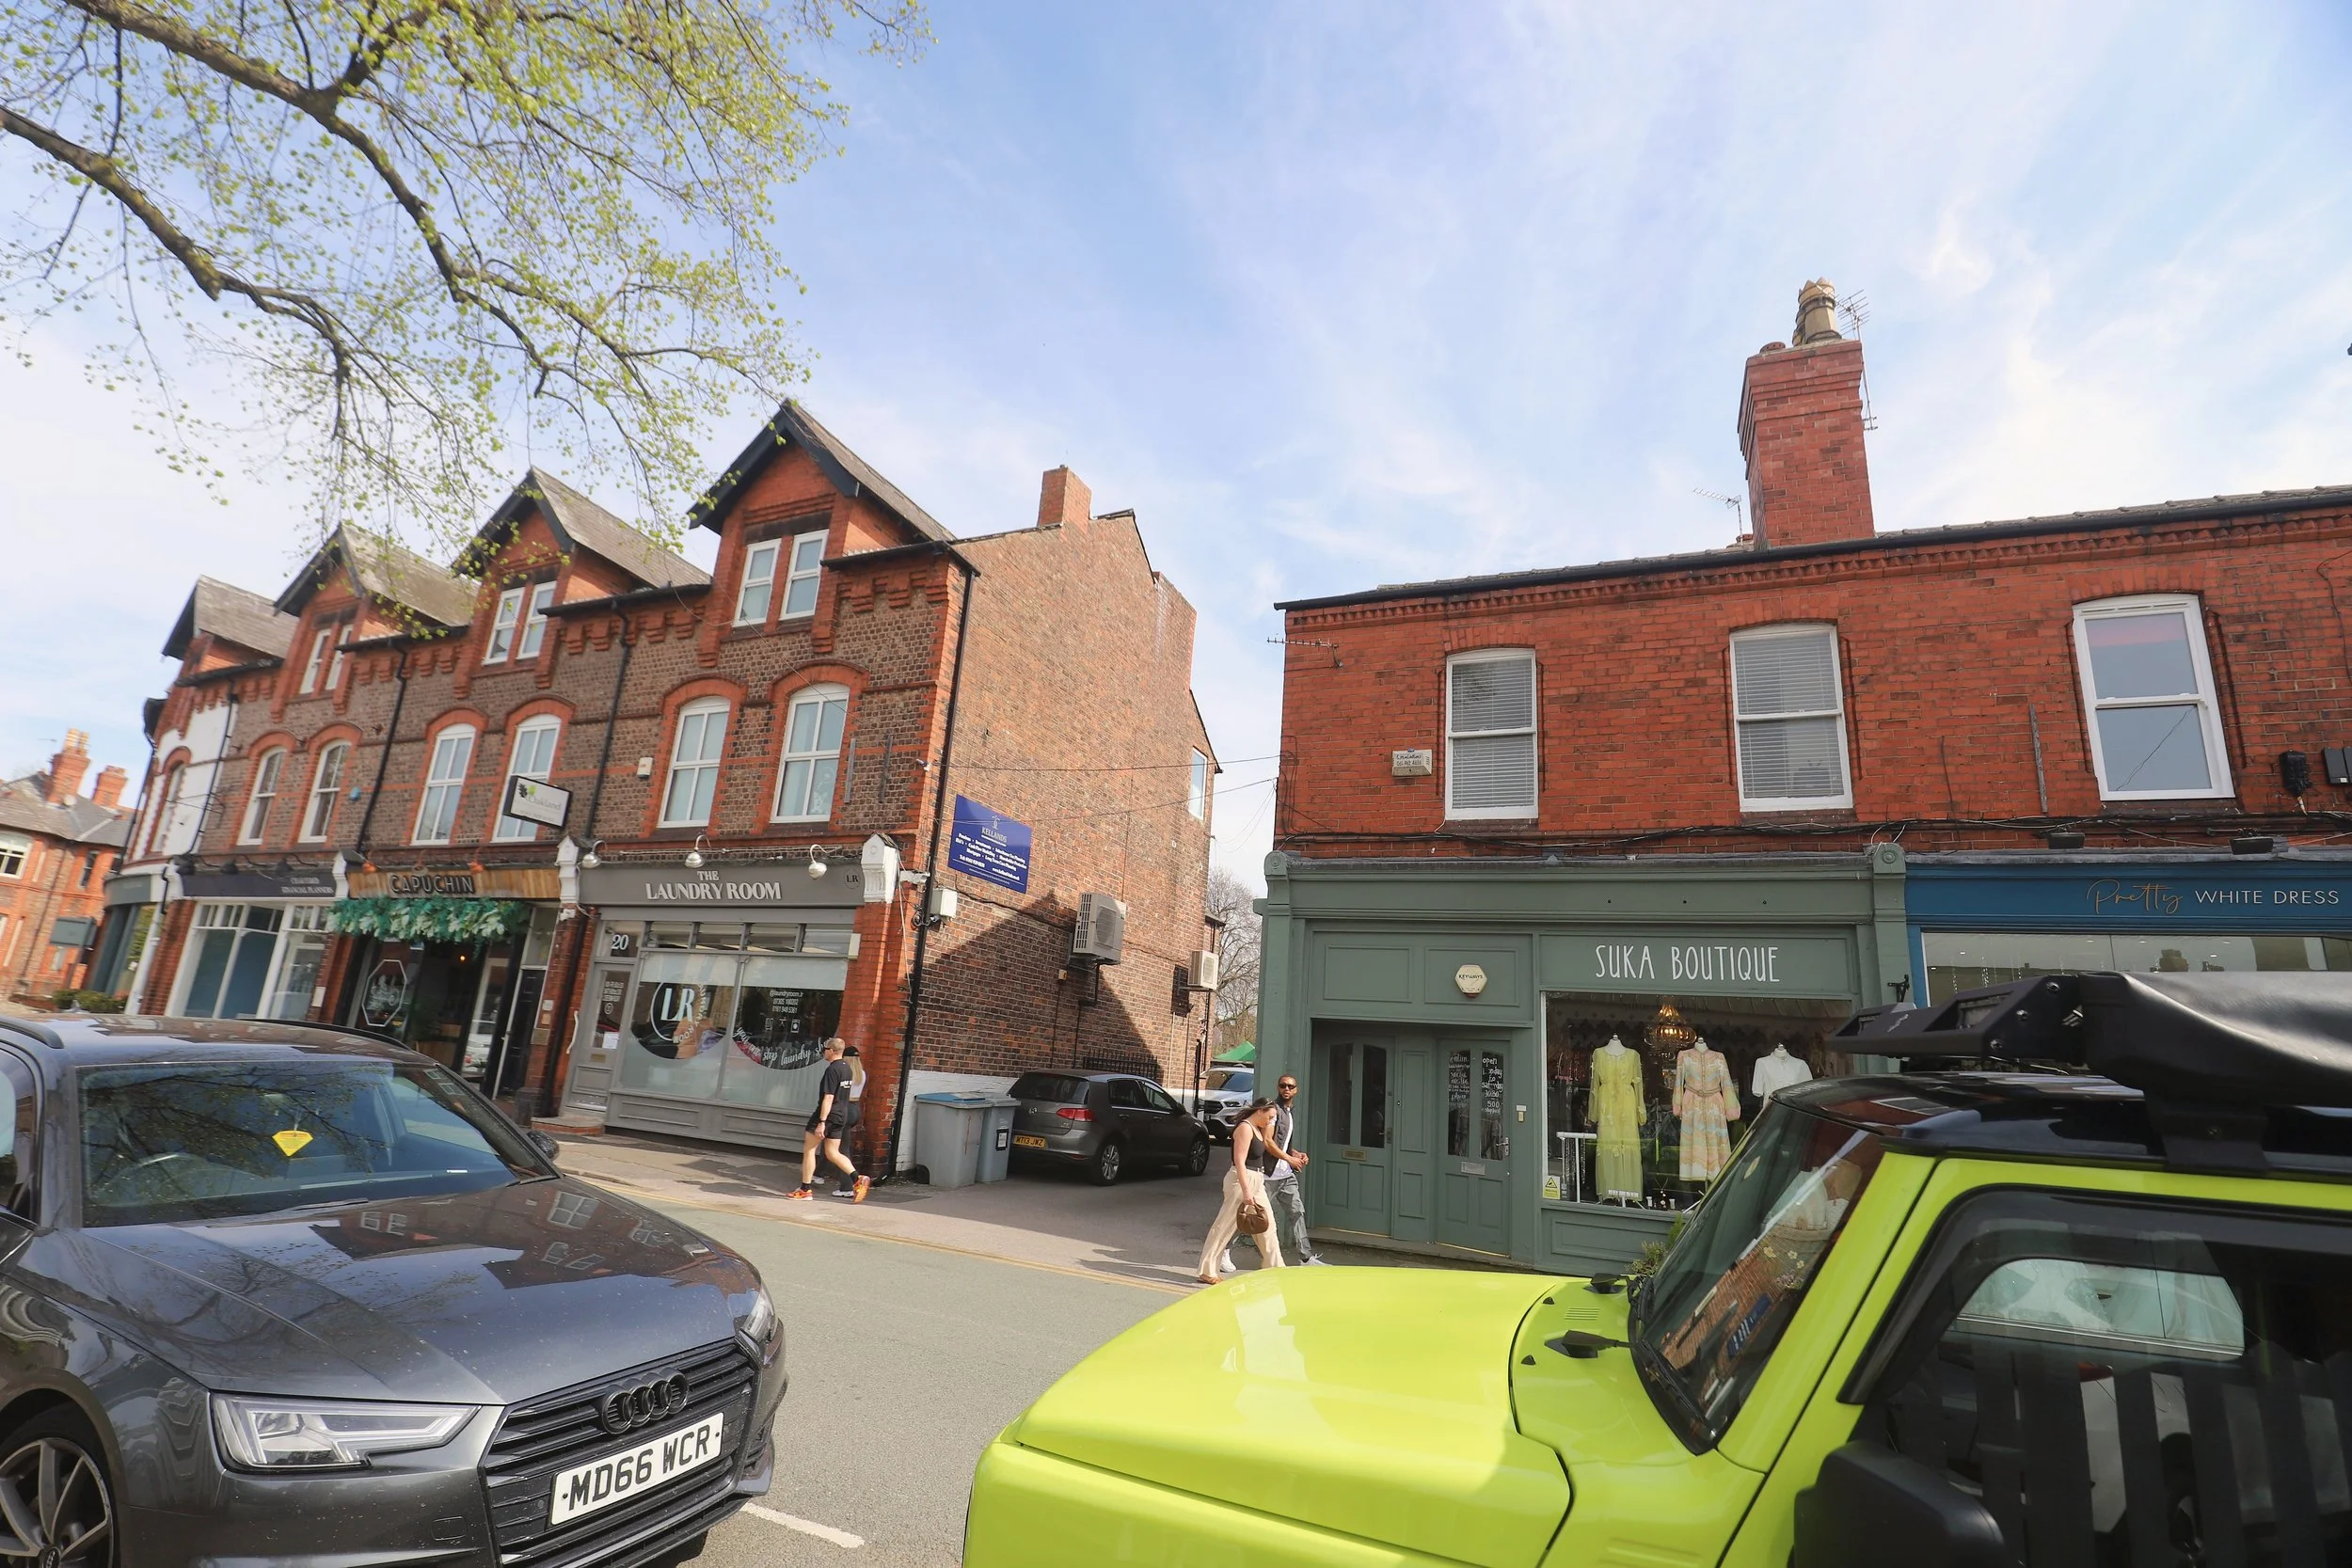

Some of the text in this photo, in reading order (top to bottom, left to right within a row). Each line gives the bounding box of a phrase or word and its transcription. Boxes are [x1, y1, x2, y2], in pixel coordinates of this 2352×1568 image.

[981, 827, 1007, 843] KELLANDS
[697, 870, 720, 881] THE
[846, 874, 859, 883] LR
[390, 876, 475, 894] CAPUCHIN
[645, 881, 782, 900] LAUNDRY ROOM
[2086, 879, 2340, 915] Pretty WHITE DRESS
[611, 934, 629, 950] 20
[1595, 944, 1781, 983] SUKA BOUTIQUE
[660, 988, 693, 1022] LR
[780, 1043, 811, 1066] laundry
[1482, 1057, 1498, 1068] open
[568, 1424, 711, 1512] MD66 WCR
